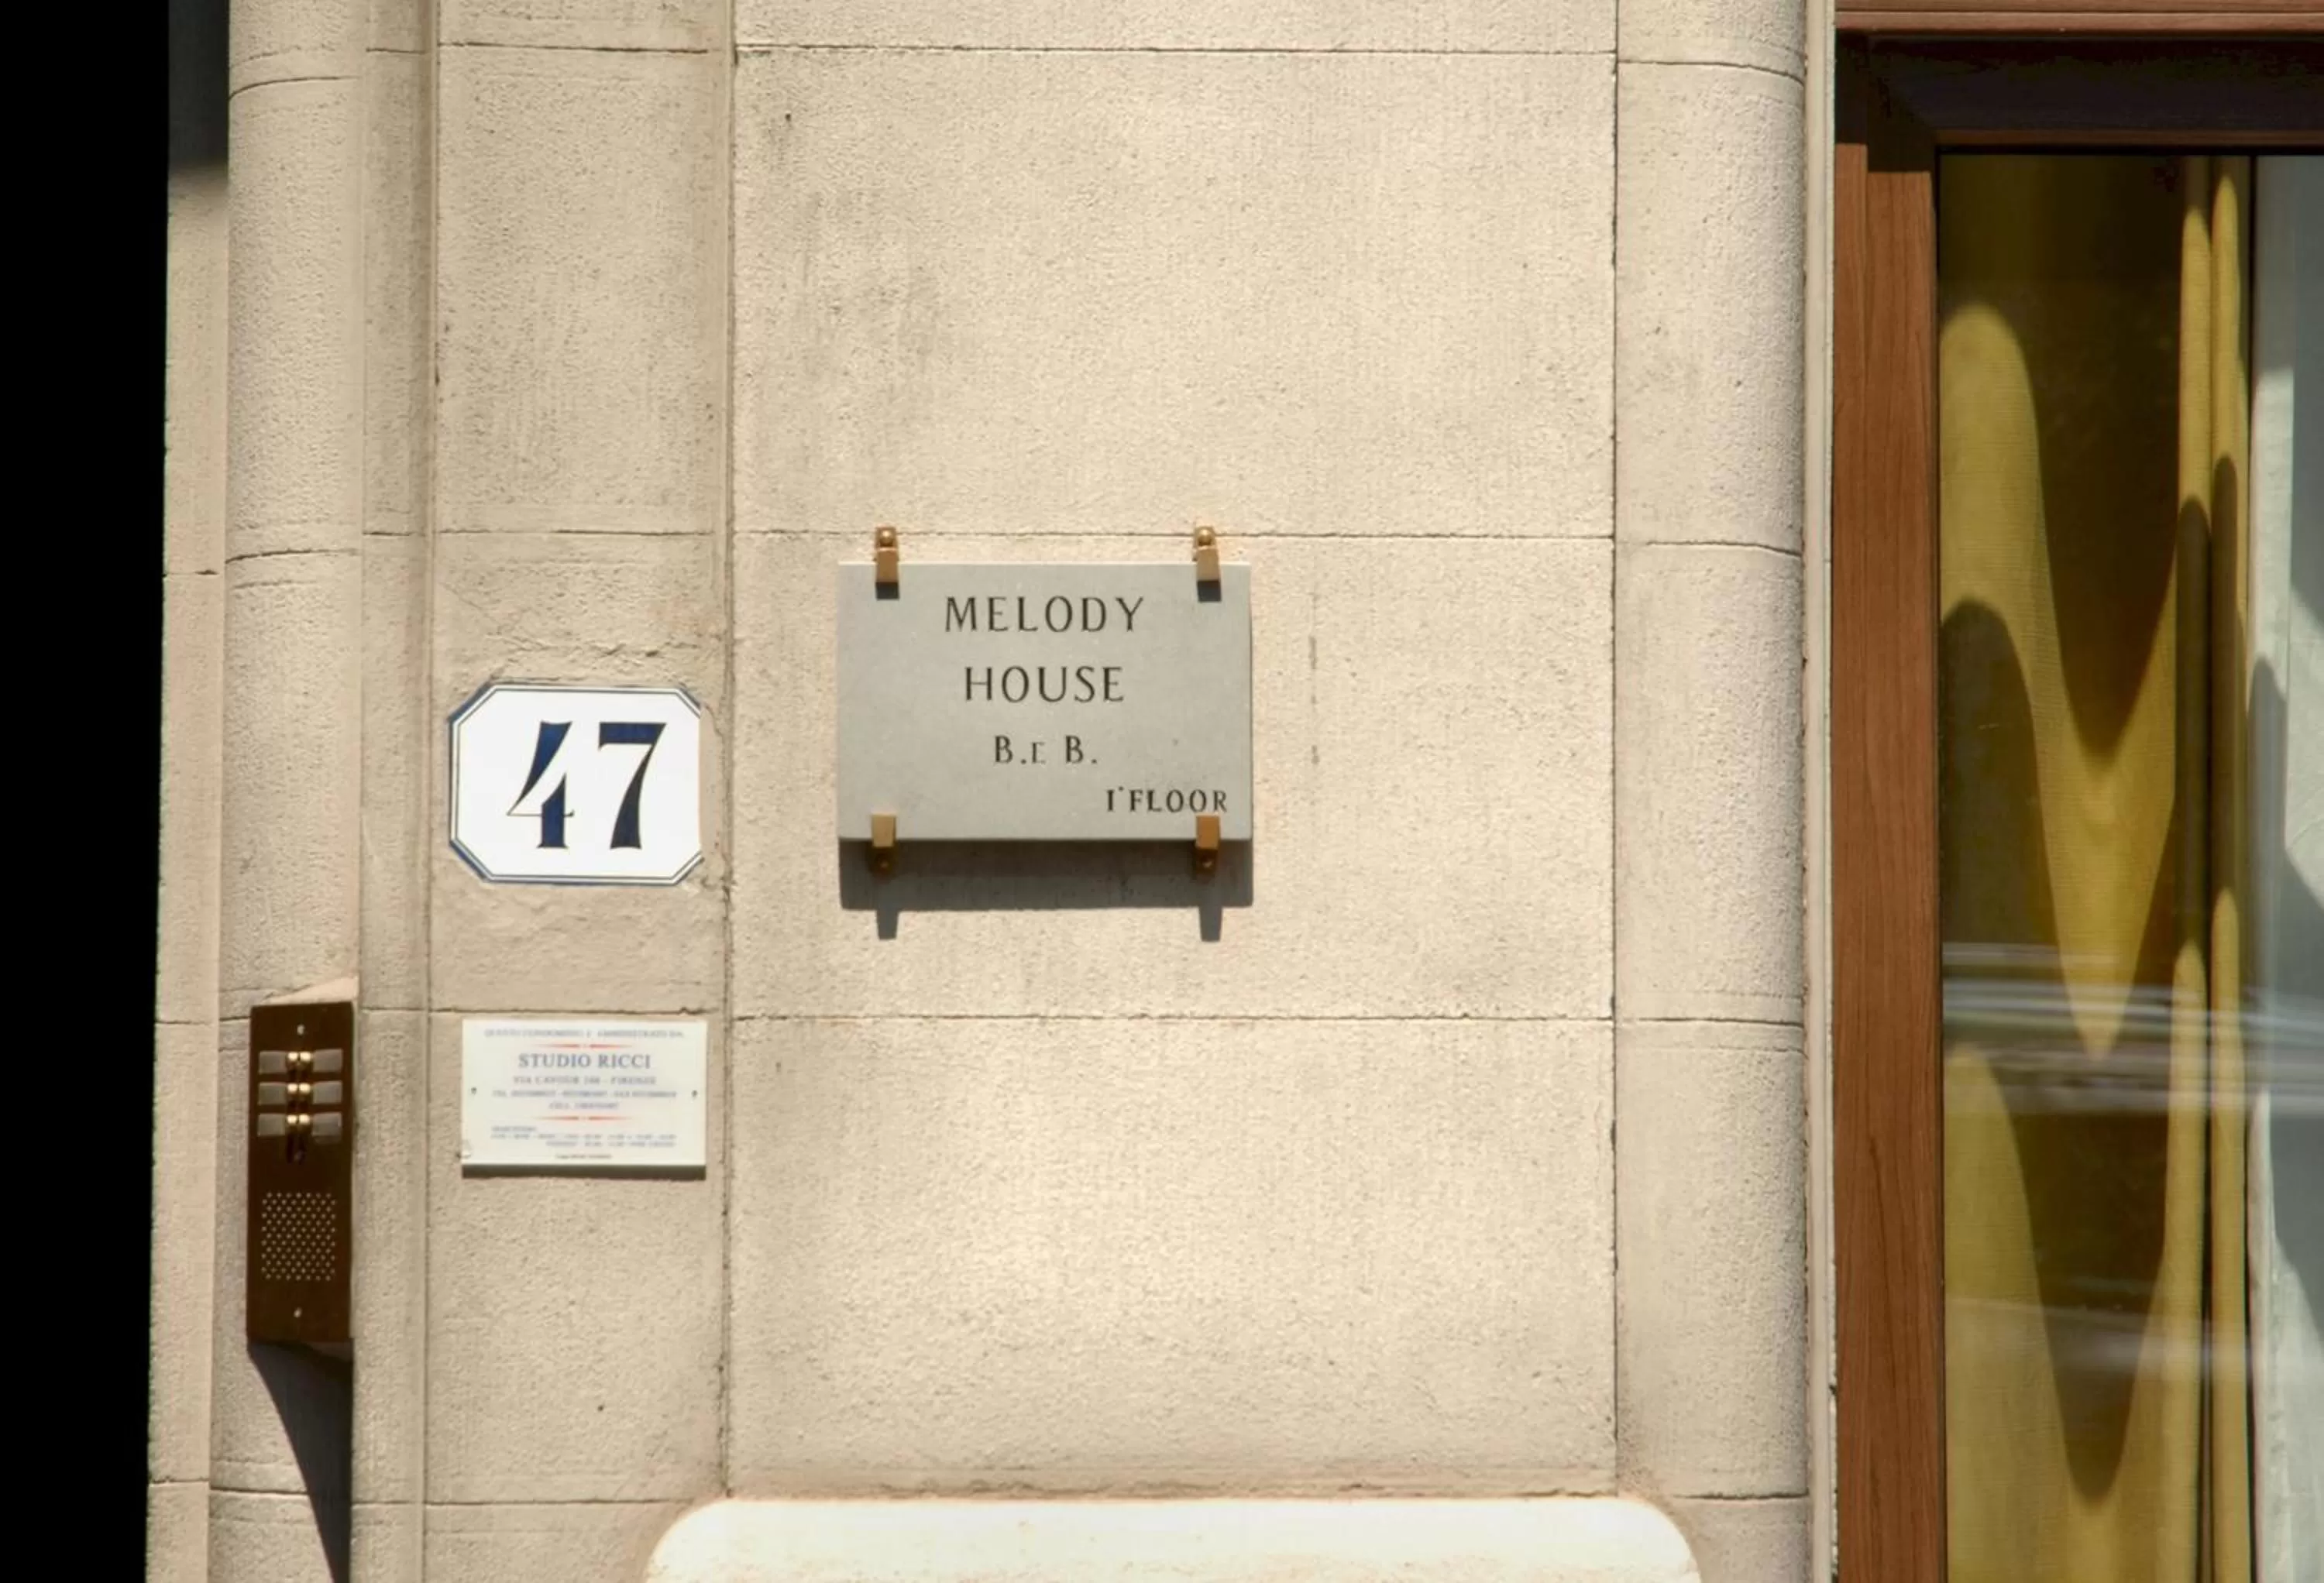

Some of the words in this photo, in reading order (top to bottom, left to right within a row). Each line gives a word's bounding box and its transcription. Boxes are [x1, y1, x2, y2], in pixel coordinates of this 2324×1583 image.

[945, 596, 1144, 633] MELODY
[964, 665, 1125, 703] HOUSE
[506, 720, 668, 850] 47
[517, 1052, 591, 1068] STUDIO
[597, 1053, 651, 1069] RICCI
